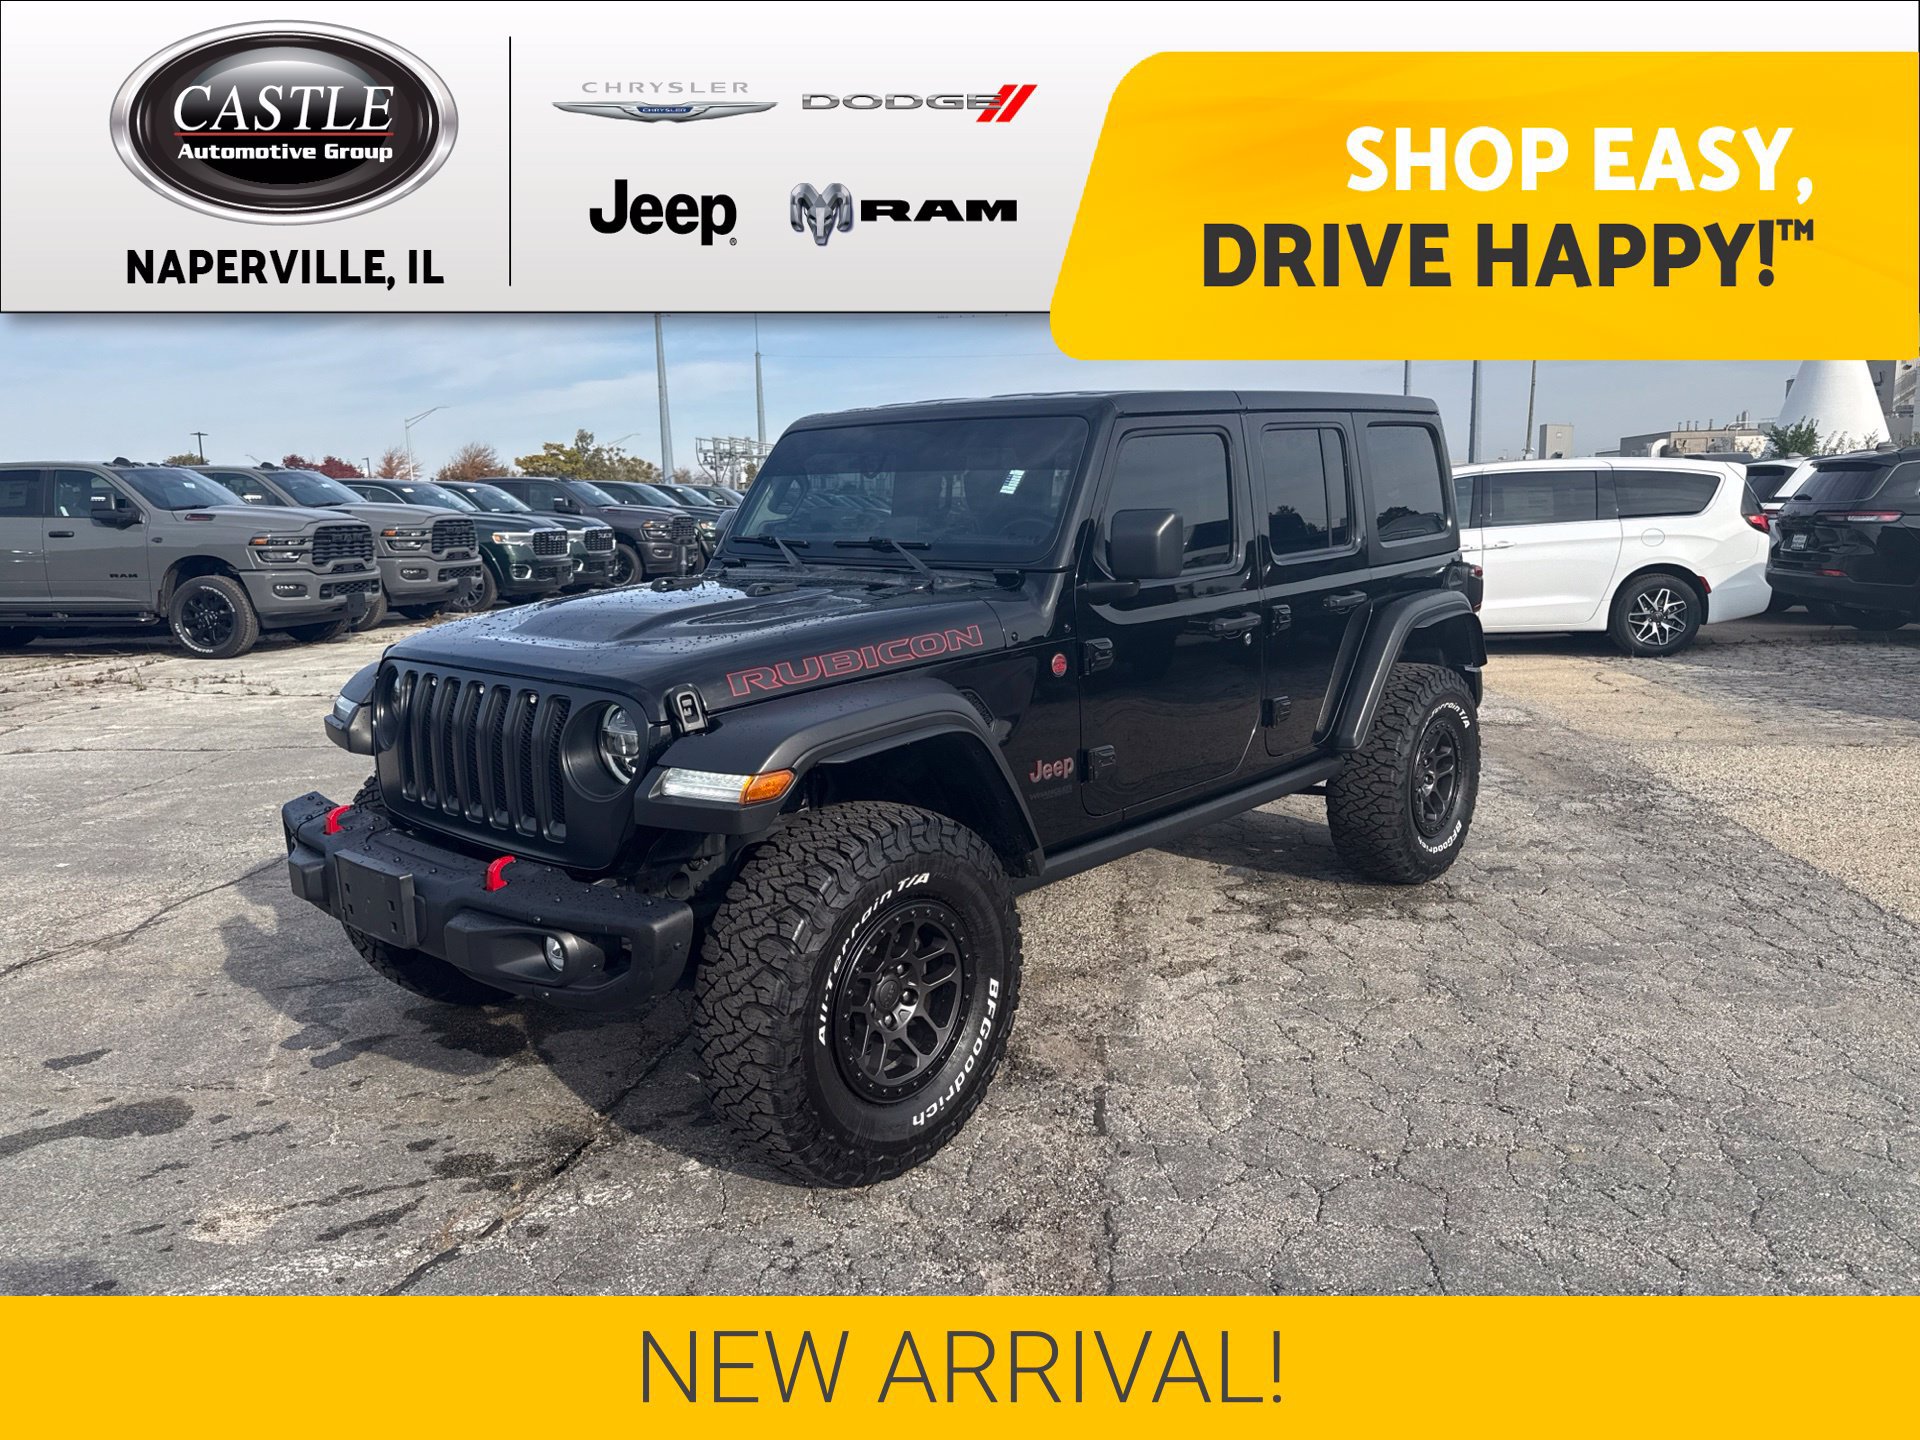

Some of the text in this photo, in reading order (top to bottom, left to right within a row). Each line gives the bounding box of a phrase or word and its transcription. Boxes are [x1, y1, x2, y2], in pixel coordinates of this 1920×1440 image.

[726, 624, 984, 697] RUBICON
[1029, 756, 1075, 783] Jeep
[898, 872, 931, 893] T/A
[912, 977, 1000, 1127] BFGoodrich
